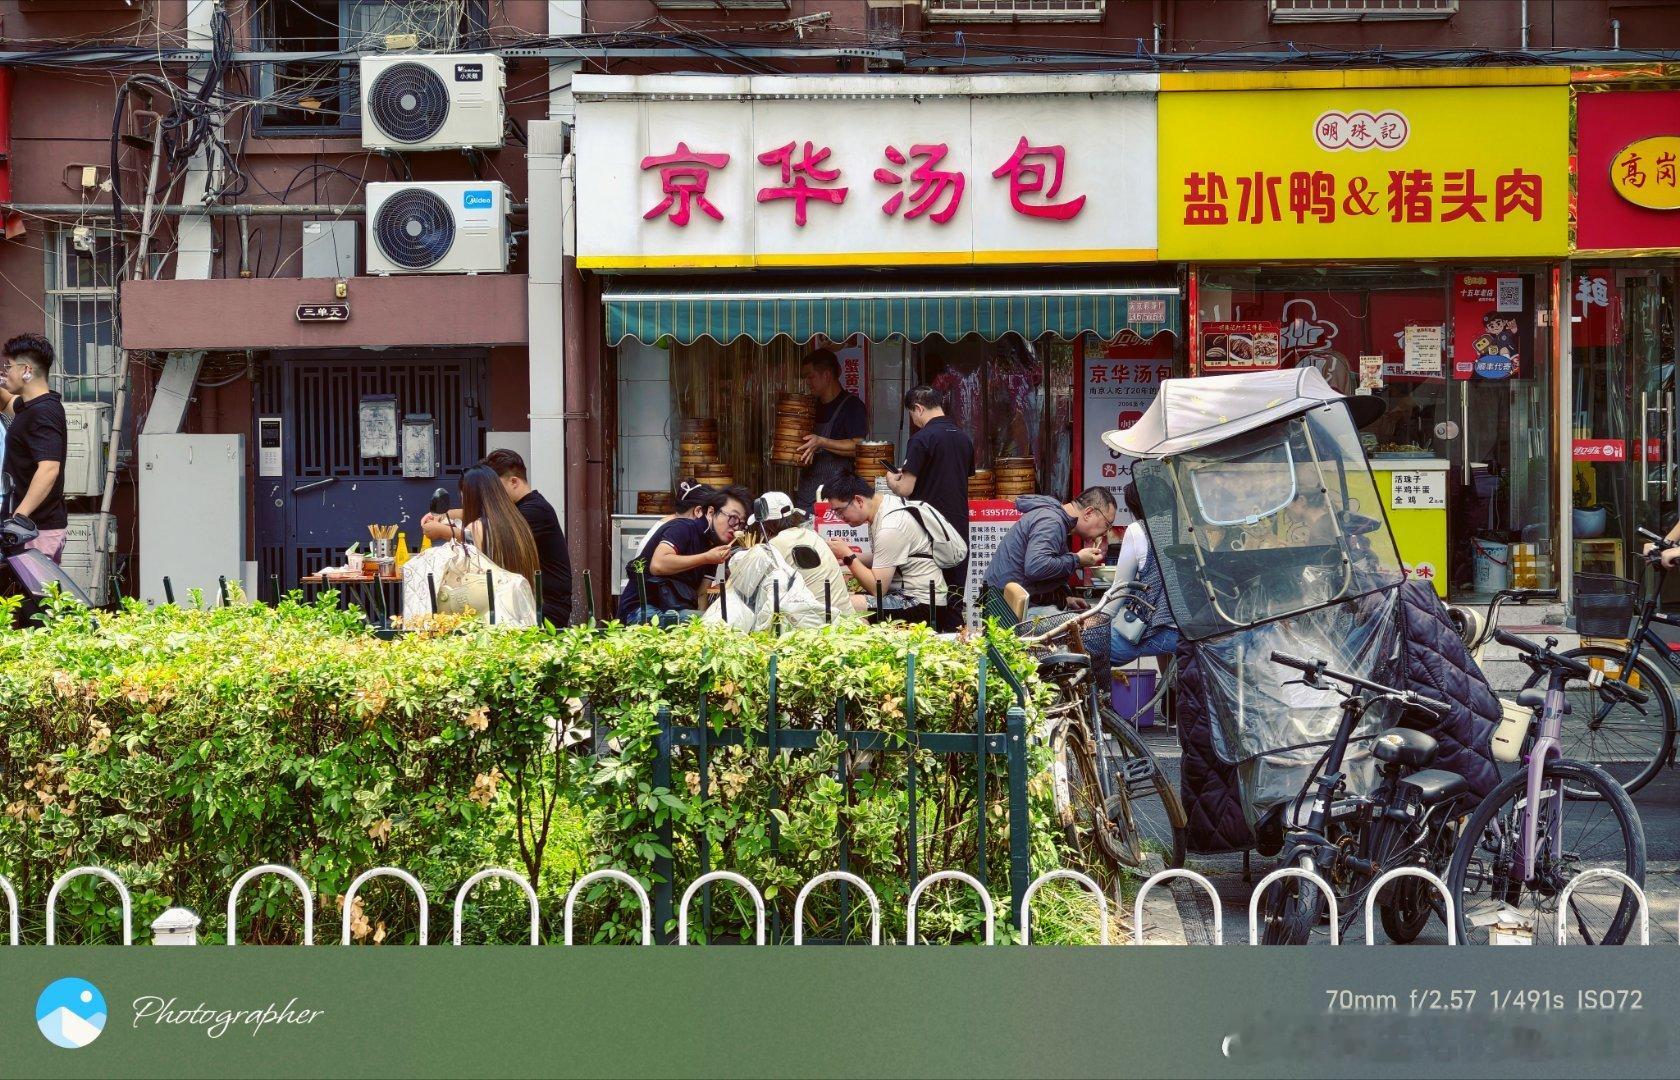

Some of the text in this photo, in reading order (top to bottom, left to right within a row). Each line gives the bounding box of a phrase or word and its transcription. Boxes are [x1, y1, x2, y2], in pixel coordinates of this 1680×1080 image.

[1321, 120, 1402, 142] 明珠記
[640, 135, 1087, 227] 京华汤包
[1183, 167, 1543, 226] 盐水鸭&猪头肉
[303, 307, 342, 317] 三单元
[1089, 364, 1172, 384] 京华汤包
[1395, 475, 1421, 484] 活珠子
[1395, 485, 1430, 494] 半鸡半蛋
[826, 529, 858, 537] 牛肉砂锅
